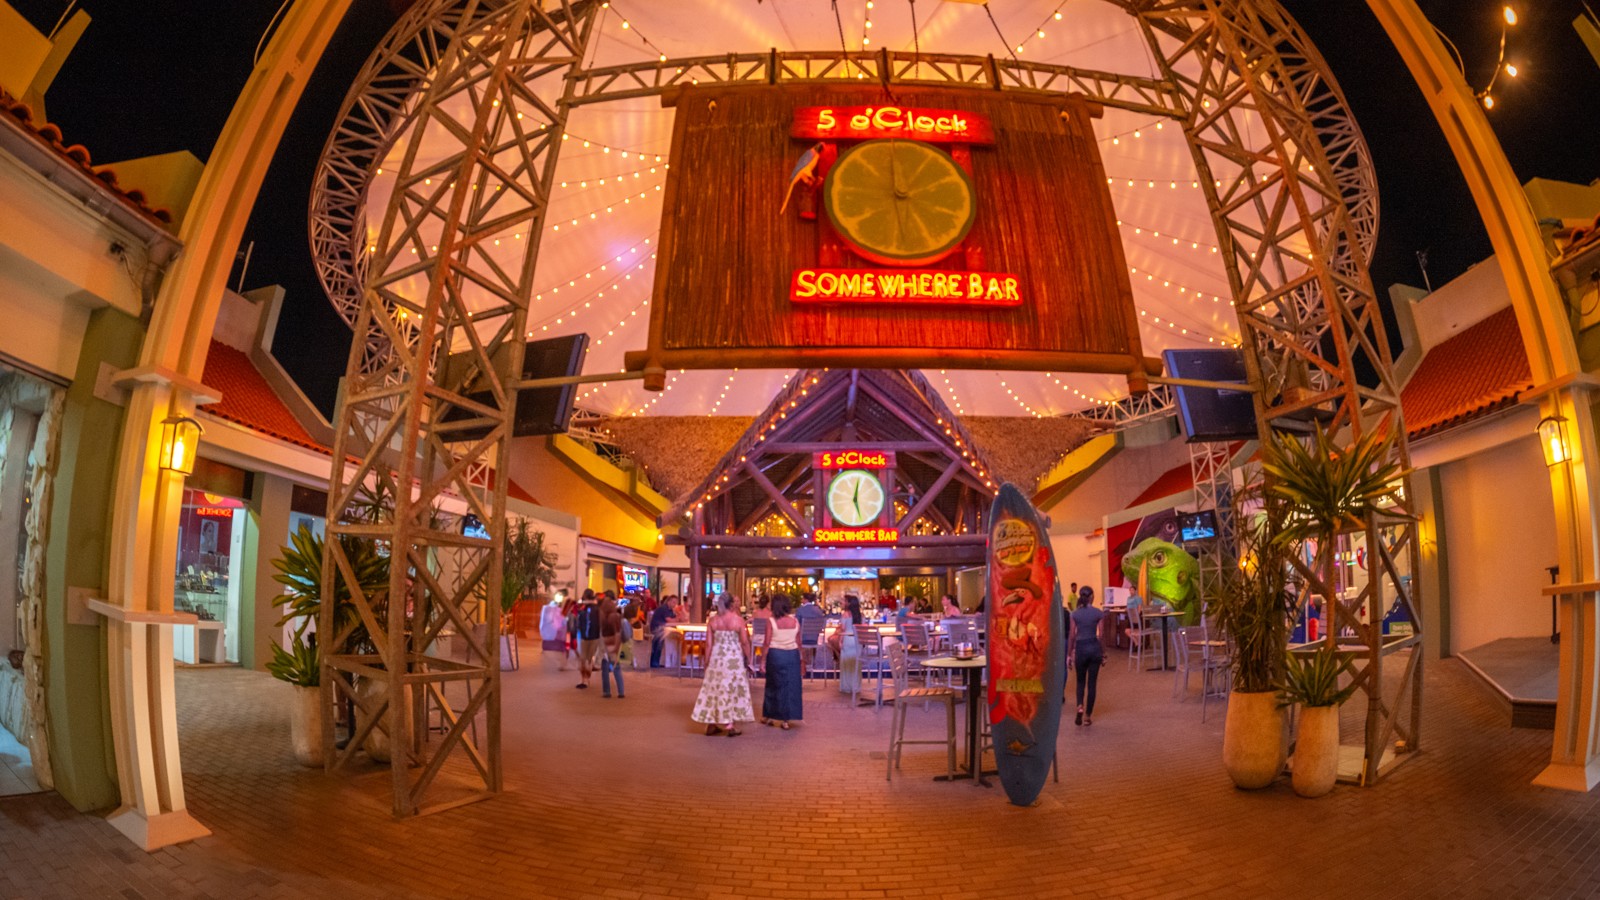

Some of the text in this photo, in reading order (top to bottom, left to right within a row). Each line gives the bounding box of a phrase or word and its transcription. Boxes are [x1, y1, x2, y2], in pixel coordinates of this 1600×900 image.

[817, 107, 968, 134] 5 o'Clock
[796, 270, 1019, 301] SOMEWHERE BAR
[822, 452, 885, 466] 5 o'Clock
[815, 529, 898, 542] SOMEWHERE BAR
